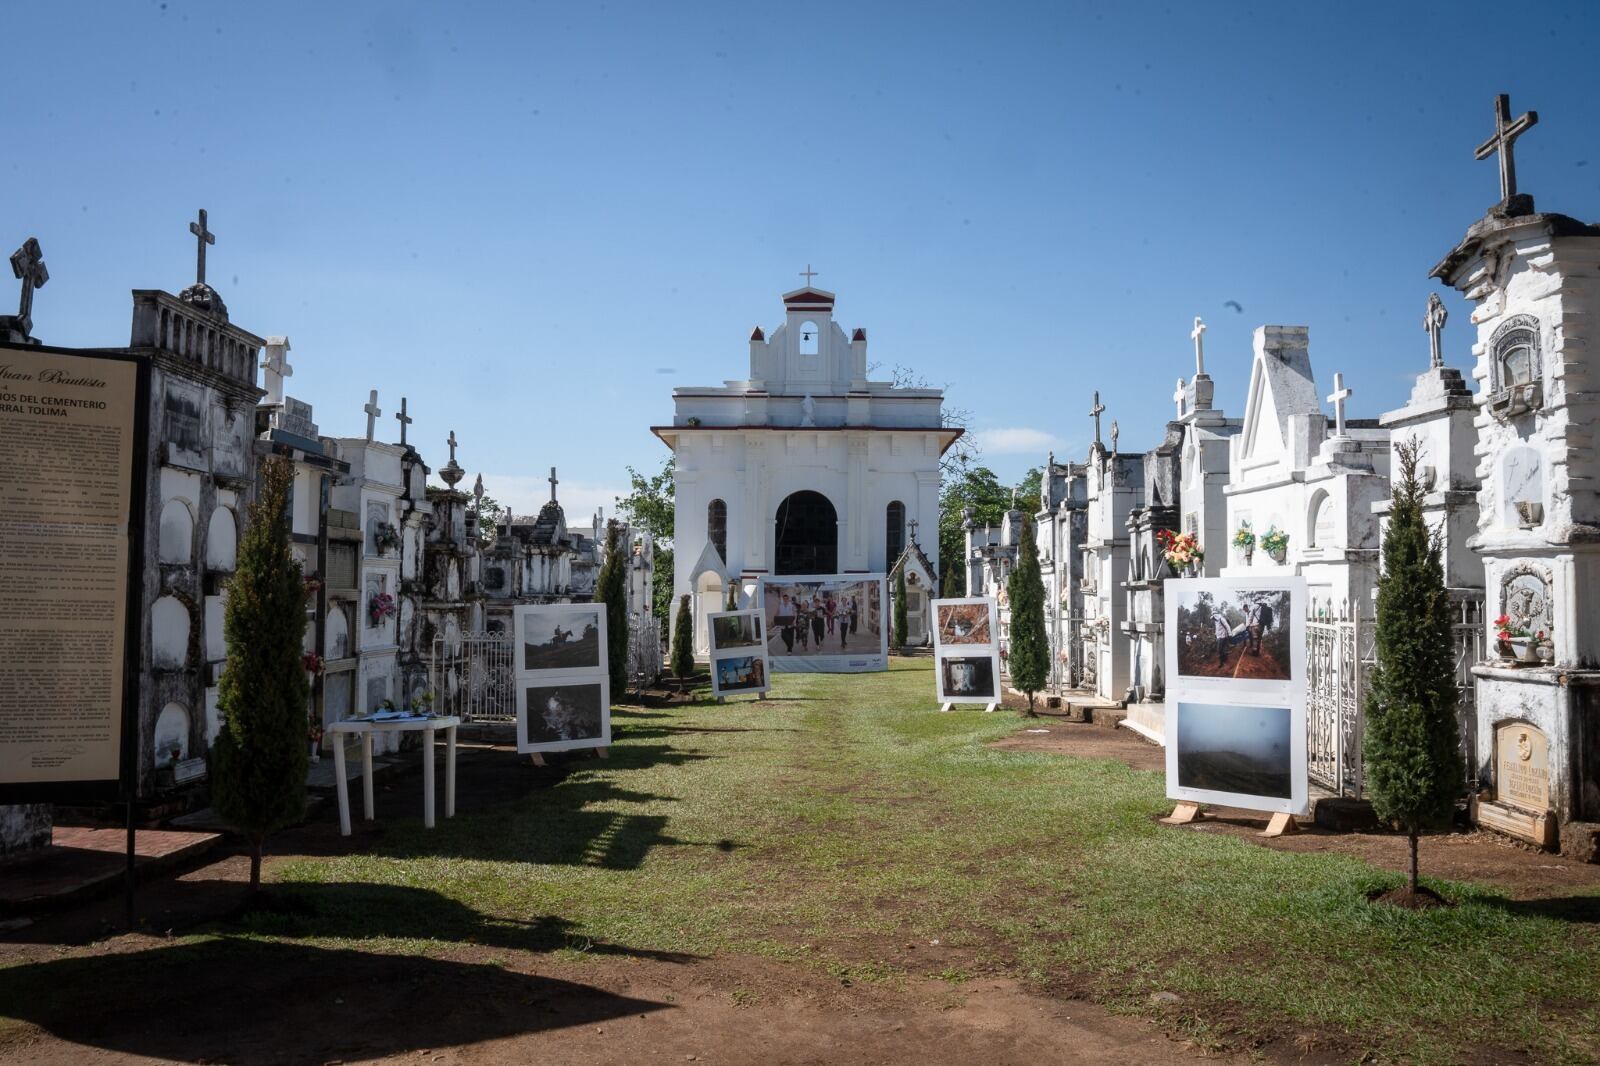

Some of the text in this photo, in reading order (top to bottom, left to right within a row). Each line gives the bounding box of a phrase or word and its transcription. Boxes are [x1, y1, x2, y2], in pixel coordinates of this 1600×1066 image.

[38, 368, 107, 388] Bautista
[19, 394, 38, 404] DEL
[41, 396, 107, 410] CEMENTERIO
[28, 406, 68, 417] TOLIMA
